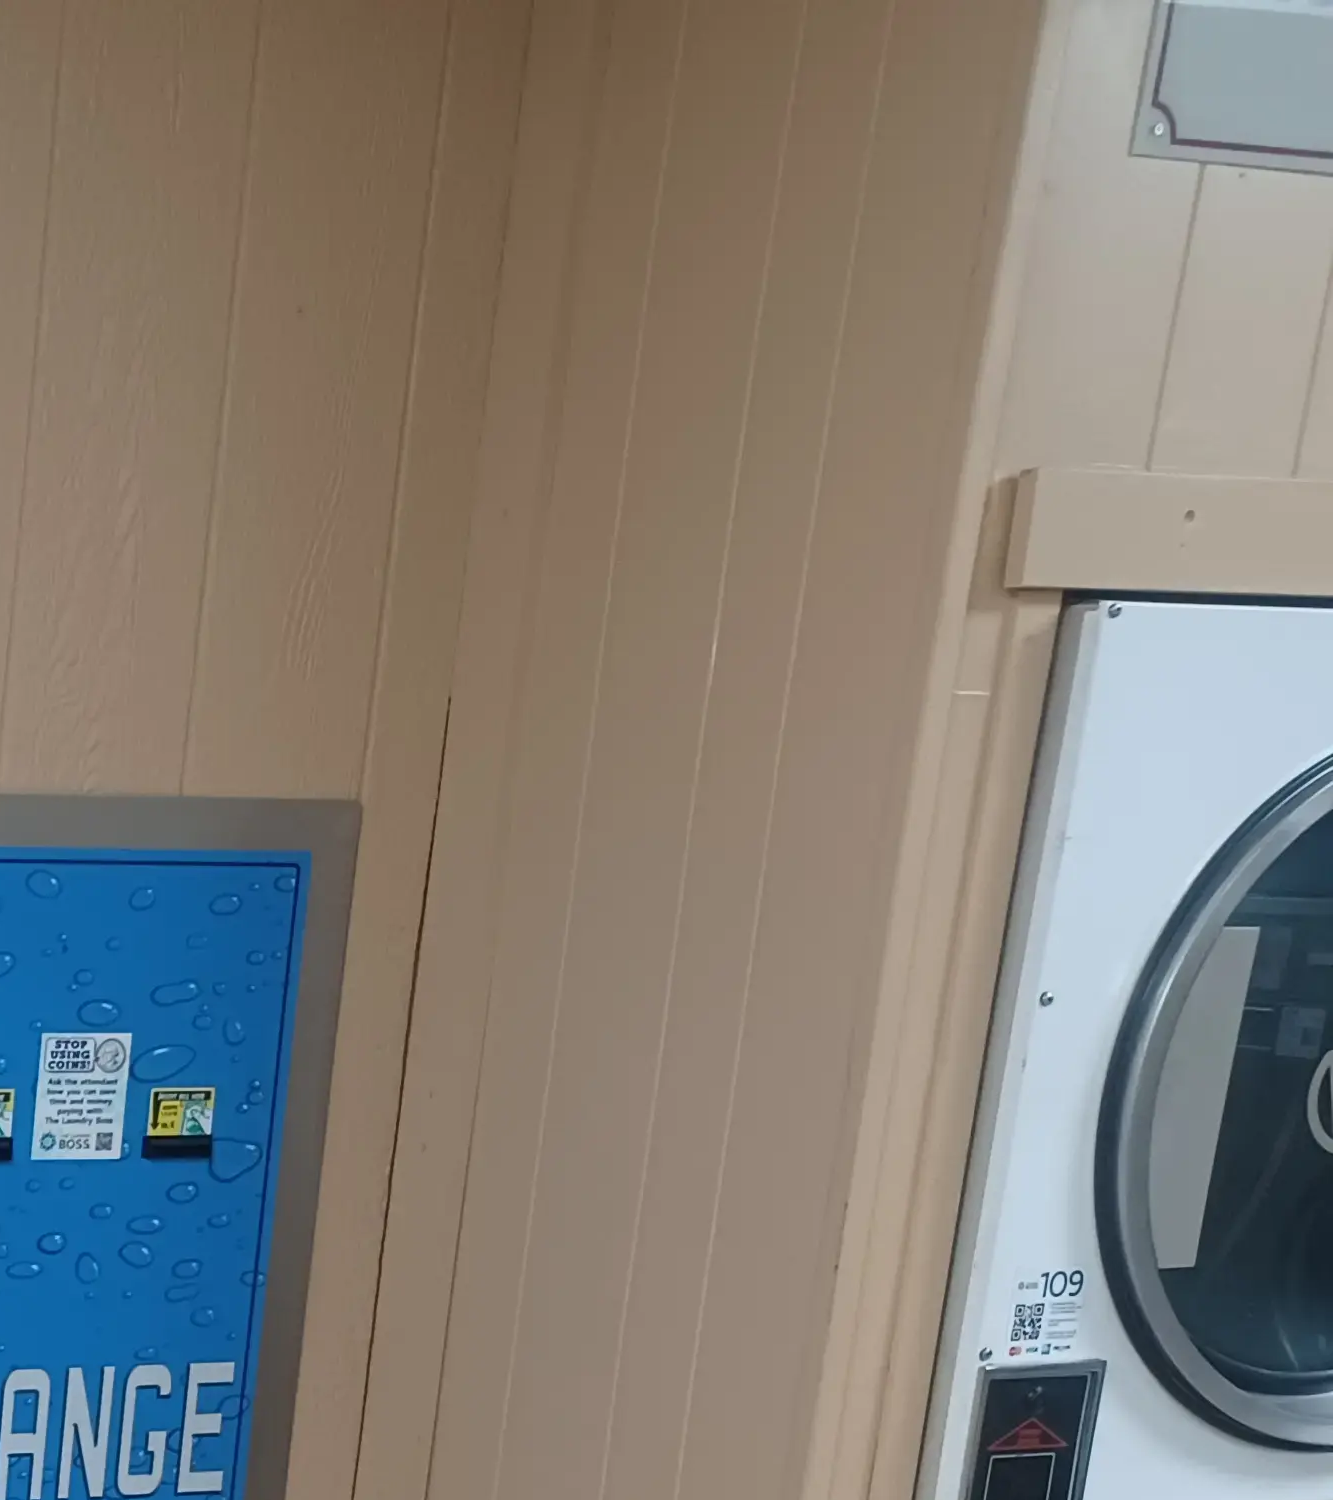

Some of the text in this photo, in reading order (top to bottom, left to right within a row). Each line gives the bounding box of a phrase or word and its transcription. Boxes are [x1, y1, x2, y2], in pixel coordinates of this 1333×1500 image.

[54, 1040, 88, 1049] STOP
[50, 1050, 90, 1059] USING
[58, 1139, 90, 1149] BOSS
[1040, 1269, 1084, 1298] 109
